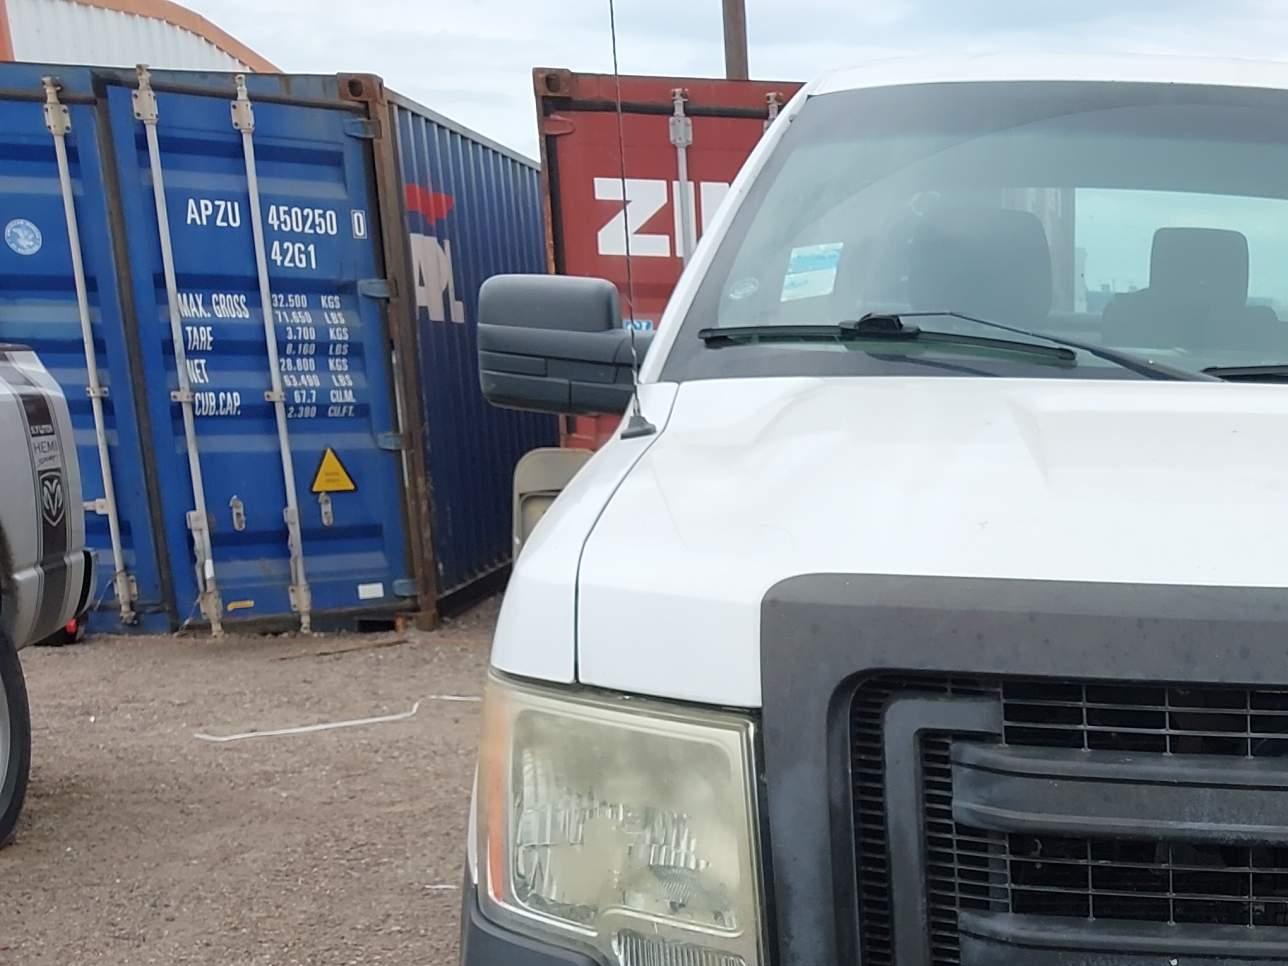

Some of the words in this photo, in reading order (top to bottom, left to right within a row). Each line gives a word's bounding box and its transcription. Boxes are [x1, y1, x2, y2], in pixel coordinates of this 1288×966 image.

[187, 199, 241, 227] APZU
[268, 204, 338, 236] 450250
[271, 240, 317, 270] 42G1
[178, 293, 212, 318] MAX.
[212, 294, 249, 318] GROSS
[272, 294, 308, 309] 32.500
[321, 295, 341, 309] KGS
[324, 312, 345, 325] LBS
[185, 326, 213, 350] TARE
[286, 327, 316, 340] 3.700
[329, 327, 349, 341] KGS
[328, 343, 349, 355] LBS
[186, 359, 209, 383] NET
[328, 358, 349, 372] KGS
[331, 374, 353, 387] LBS
[194, 391, 241, 416] CUB.CAP.
